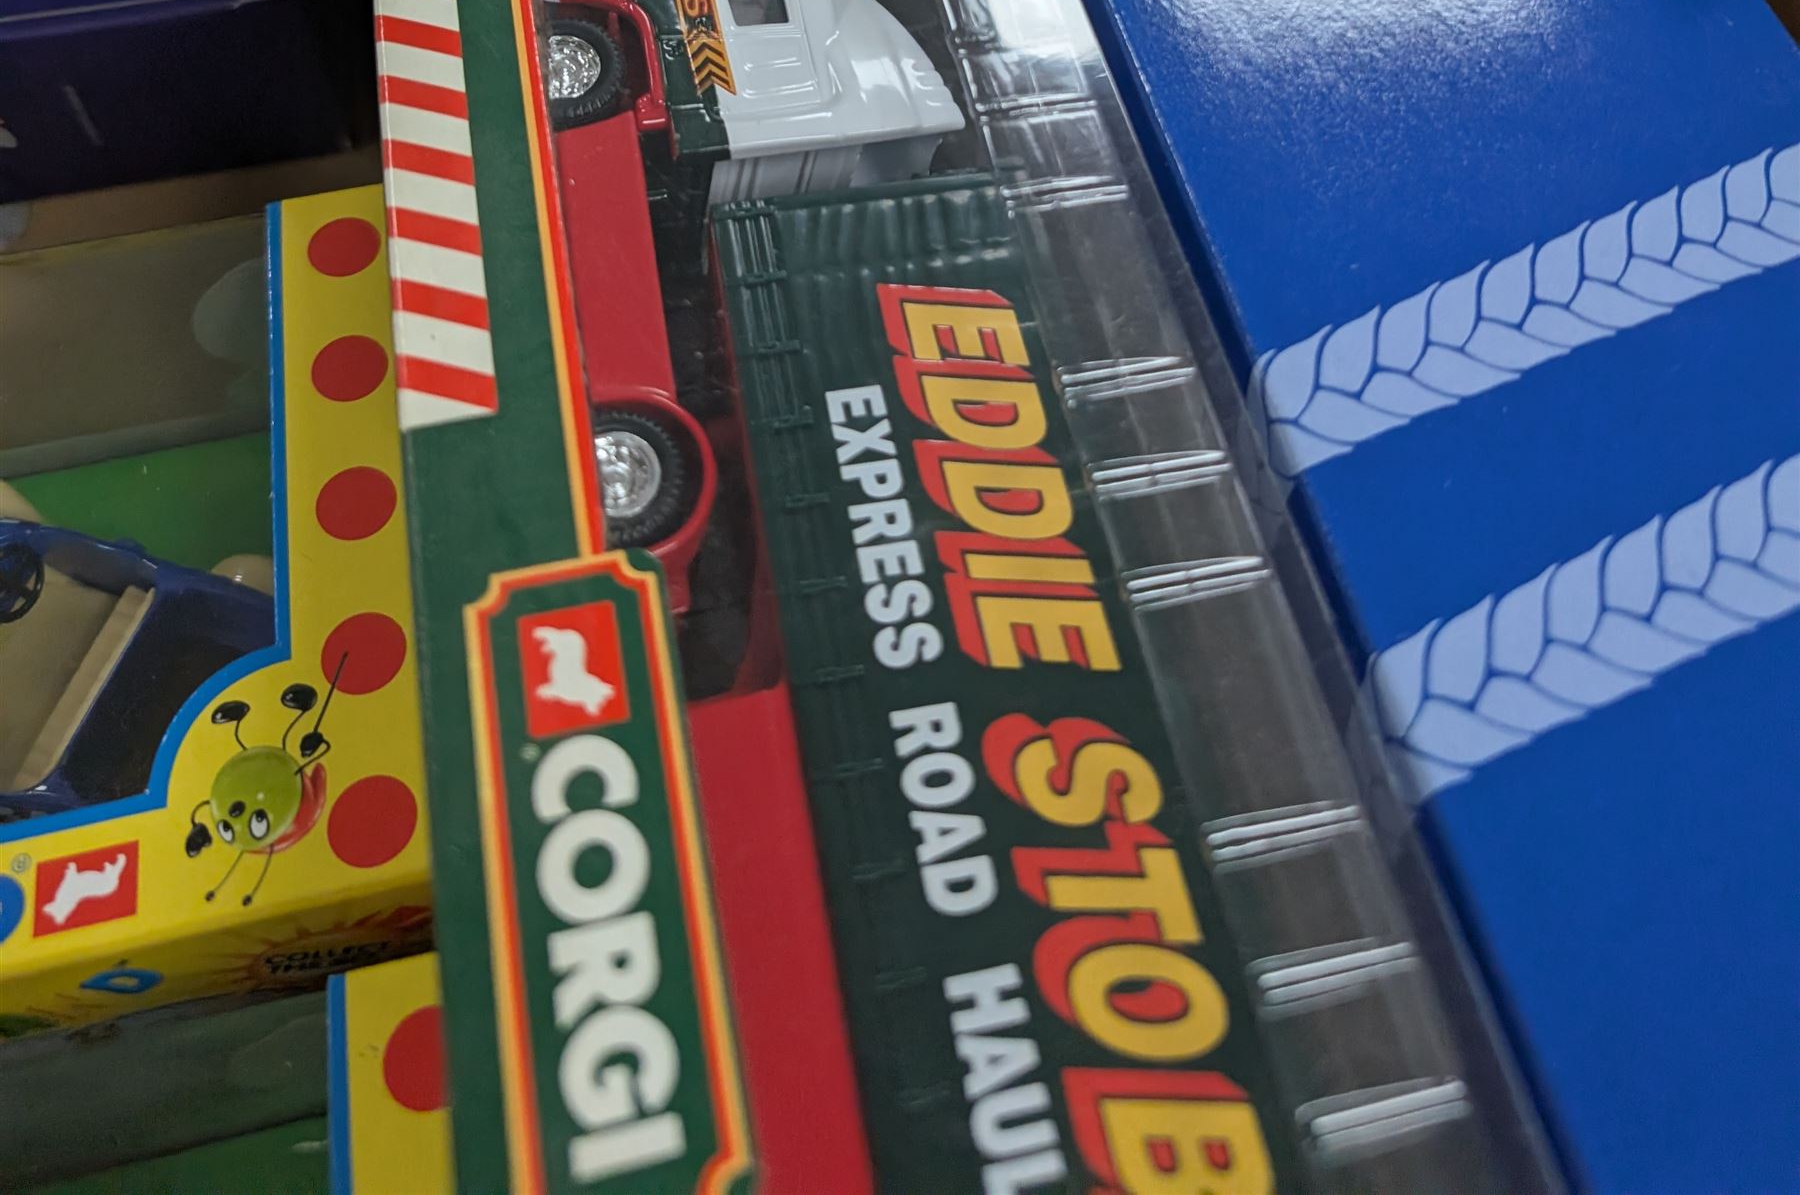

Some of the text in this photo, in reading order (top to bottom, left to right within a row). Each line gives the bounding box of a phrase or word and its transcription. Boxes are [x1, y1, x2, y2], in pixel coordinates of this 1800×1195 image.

[876, 281, 1123, 673] EDDIE
[530, 733, 687, 1184] CORGI
[824, 384, 1068, 1195] EXPRESS ROAD HAUL
